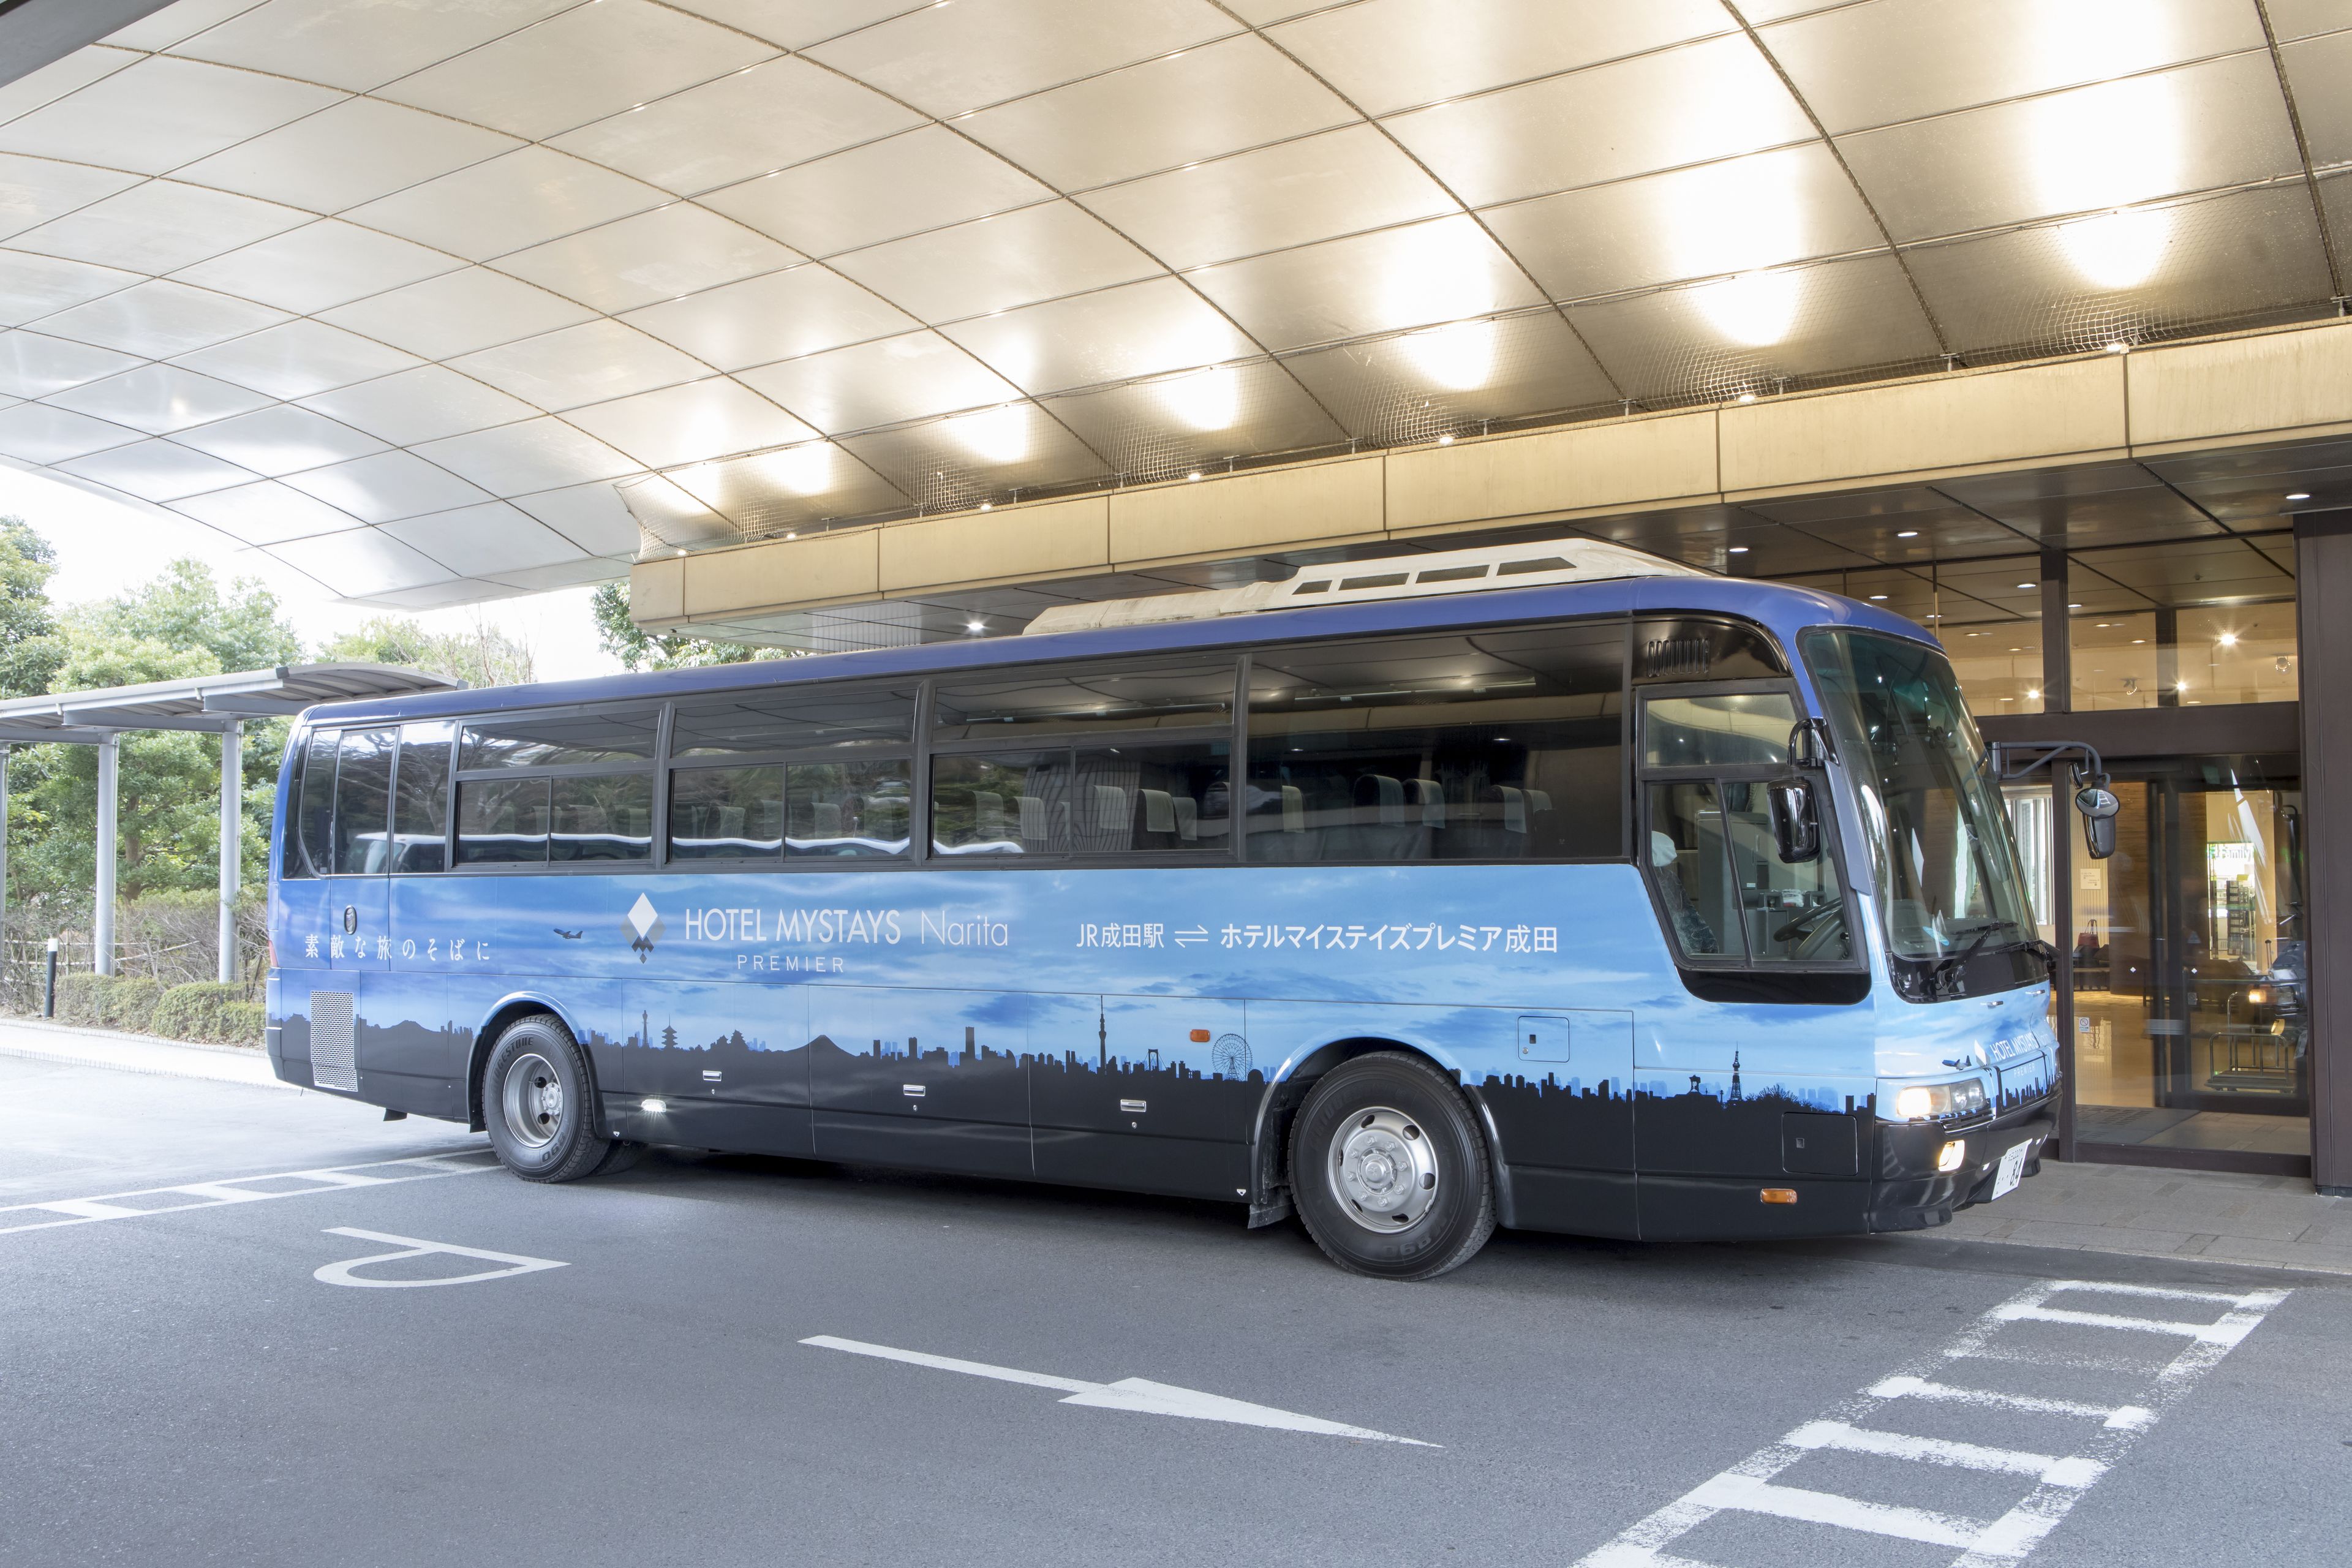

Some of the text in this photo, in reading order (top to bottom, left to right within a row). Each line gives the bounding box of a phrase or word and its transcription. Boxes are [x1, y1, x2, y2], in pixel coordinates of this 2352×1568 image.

[685, 908, 1009, 947] HOTEL MYSTAYS Narita
[1076, 922, 1558, 953] JR成田駅 ホテルマイステイズプレミア成田
[304, 933, 491, 962] 素敵な旅のそばに
[737, 954, 845, 973] PREMIER
[1989, 1039, 2015, 1061] HOTEL
[2010, 1031, 2039, 1055] MYSTAYS
[2013, 1063, 2037, 1078] PREMIER
